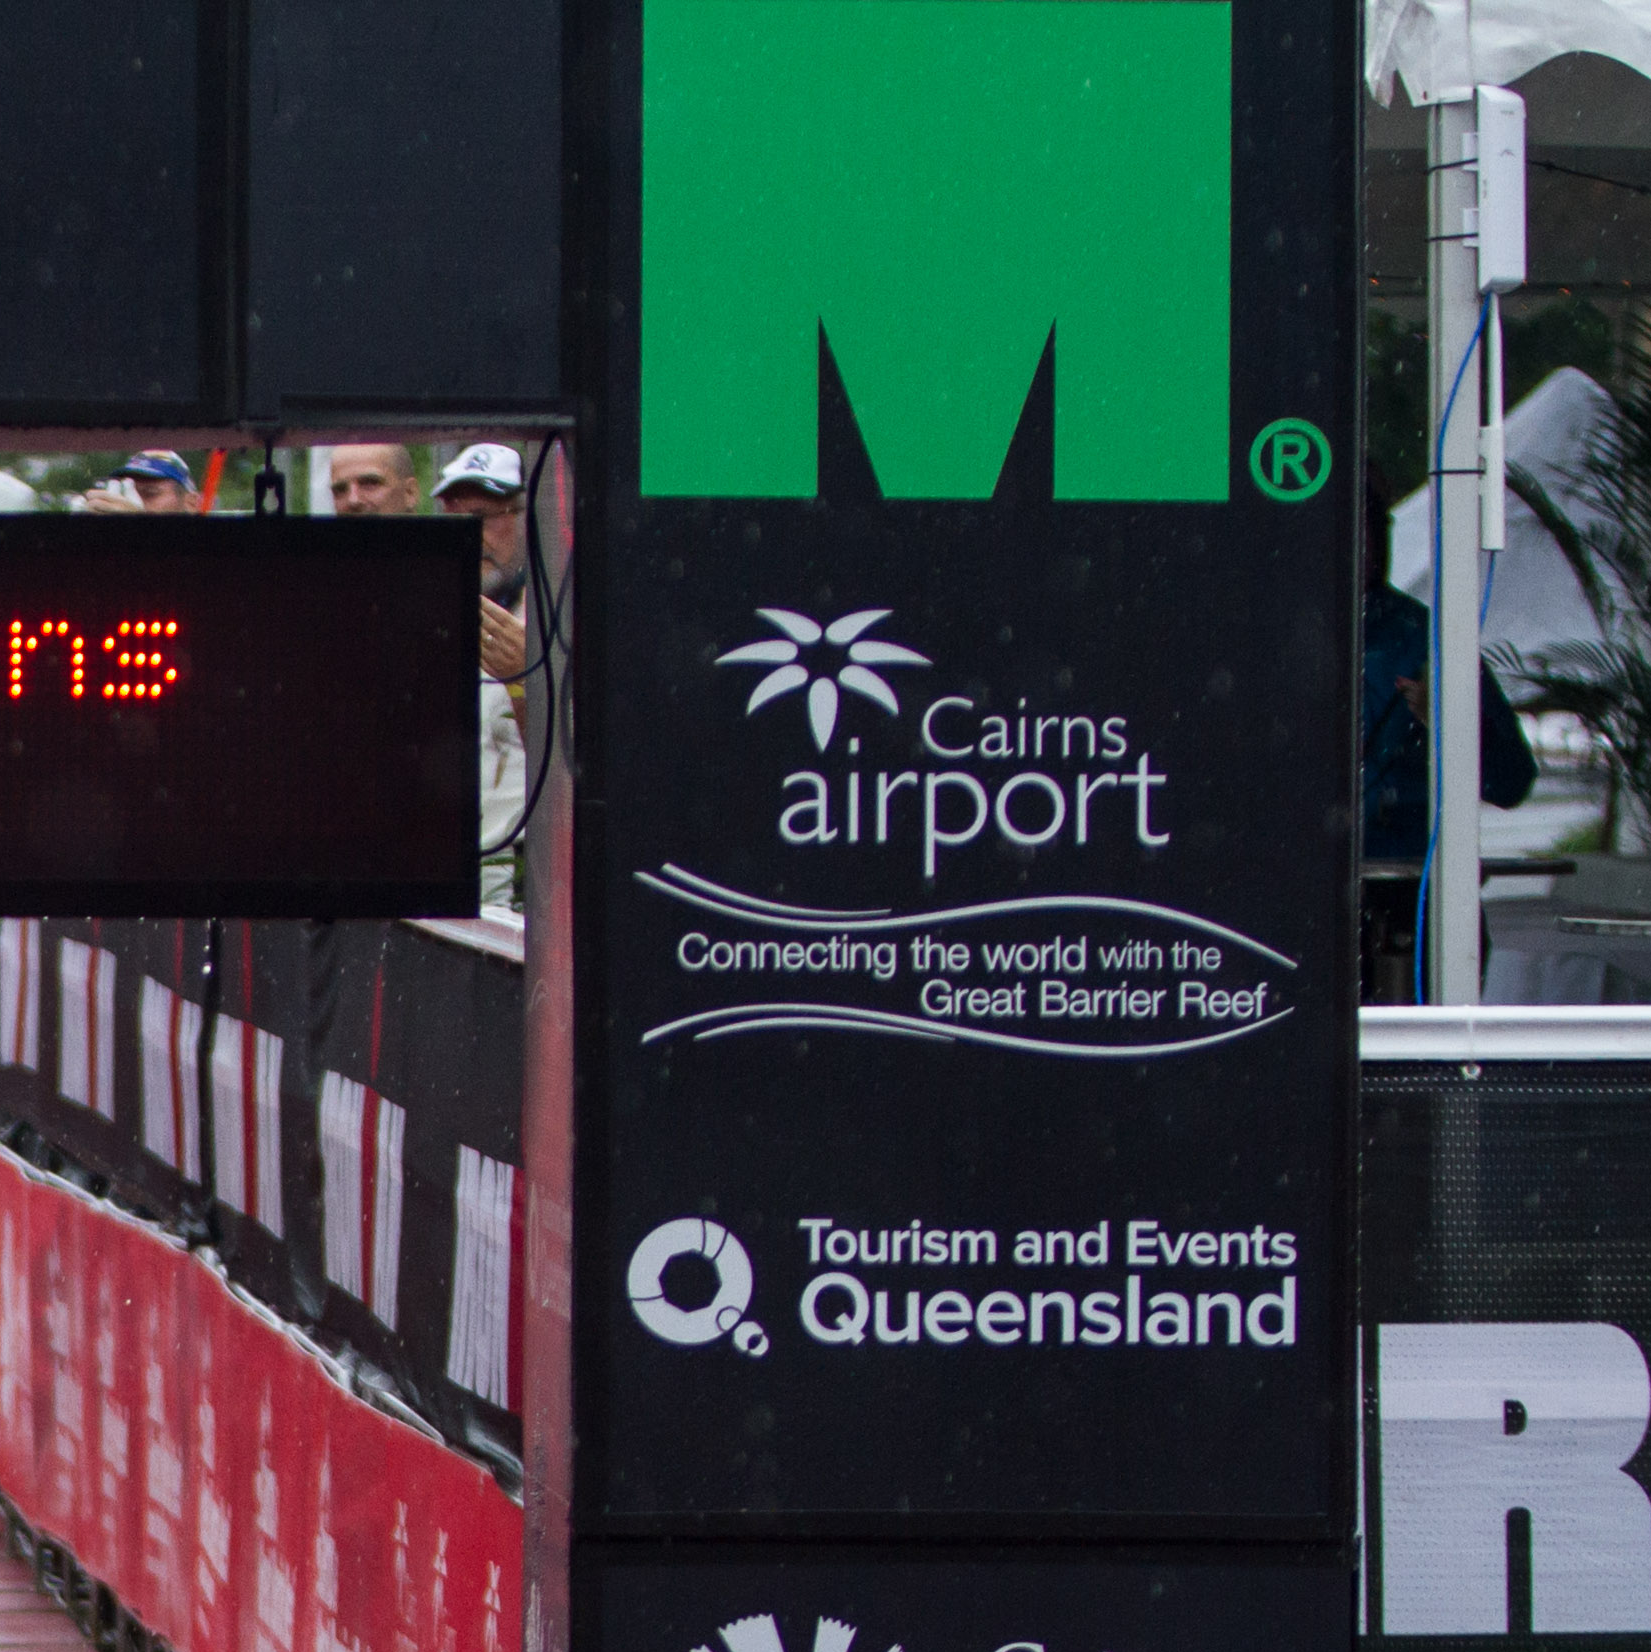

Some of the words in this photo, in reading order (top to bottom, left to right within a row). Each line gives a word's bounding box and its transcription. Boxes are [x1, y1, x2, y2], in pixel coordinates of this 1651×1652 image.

[921, 696, 1127, 759] Cairns
[778, 738, 1170, 877] airport
[677, 932, 897, 980] Connecting
[910, 934, 970, 971] the
[982, 935, 1087, 972] world
[1099, 939, 1163, 969] with
[1171, 940, 1222, 970] the
[917, 978, 1026, 1022] Great
[1040, 980, 1167, 1017] Barrier
[1177, 980, 1267, 1018] Reef
[798, 1218, 997, 1264] Tourism
[1013, 1220, 1109, 1265] and
[1127, 1220, 1297, 1267] Events
[799, 1271, 1296, 1346] Queensland
